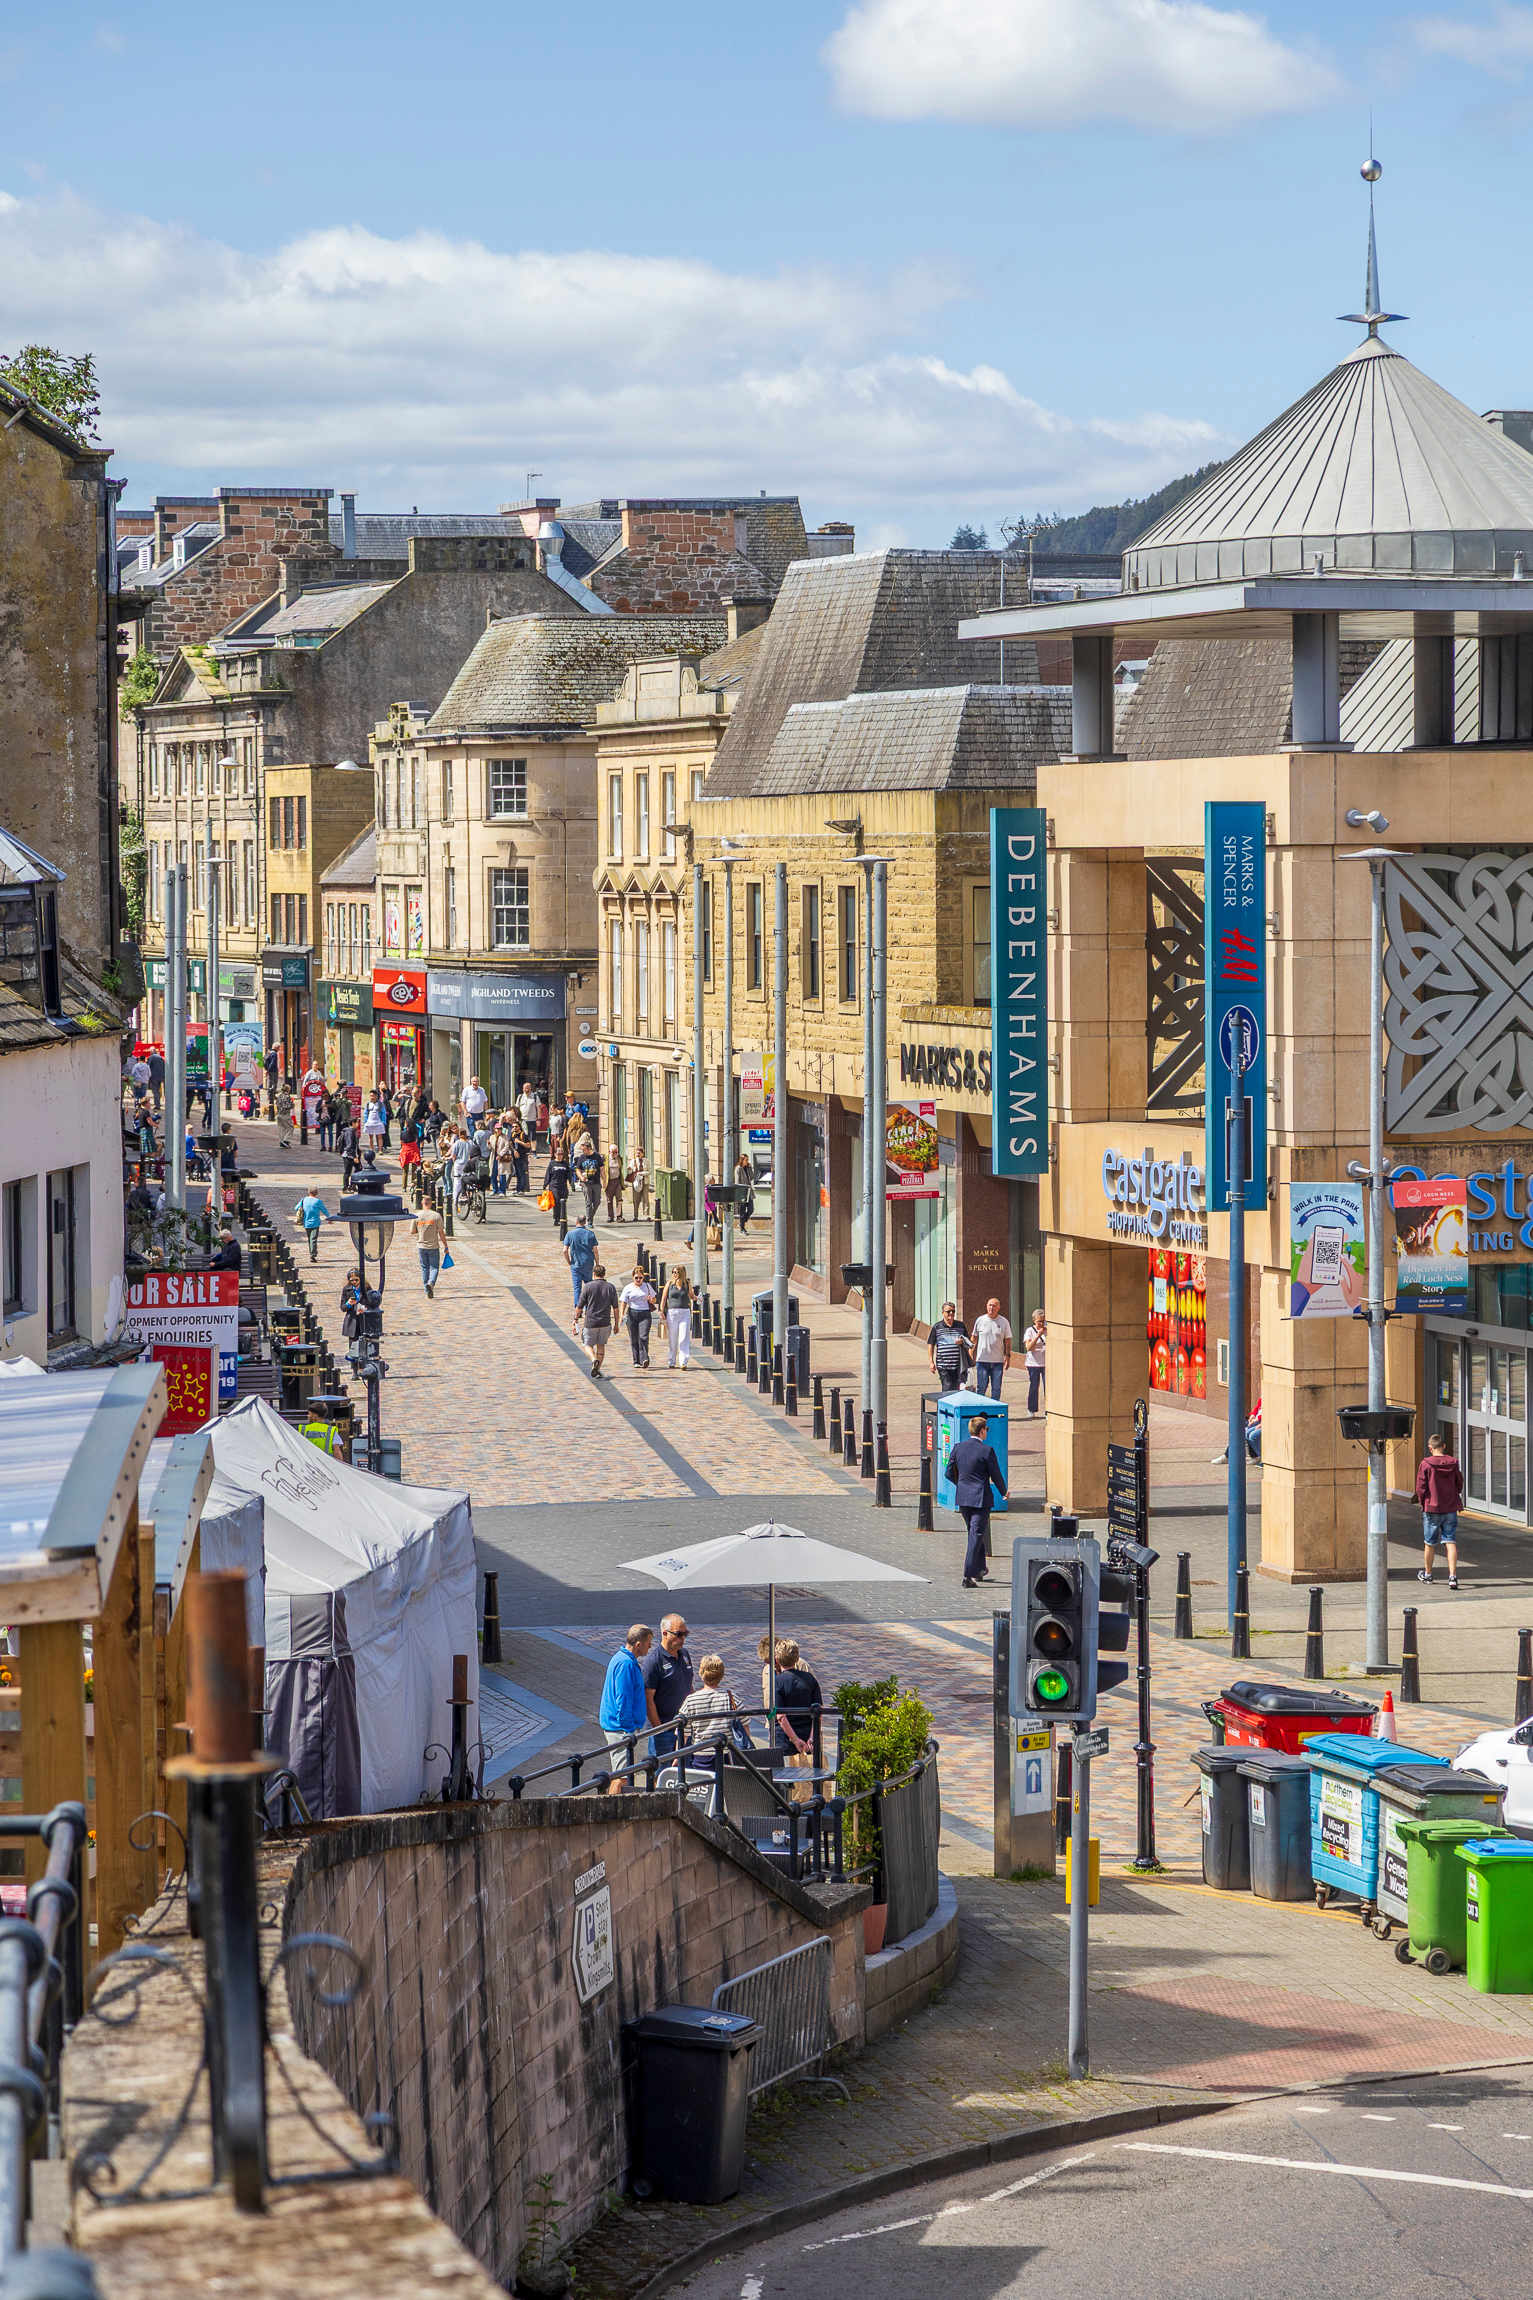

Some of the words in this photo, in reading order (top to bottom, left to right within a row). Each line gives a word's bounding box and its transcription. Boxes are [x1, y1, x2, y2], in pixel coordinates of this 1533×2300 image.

[1223, 835, 1237, 907] SPENCER
[1240, 835, 1254, 891] MARKS
[1241, 896, 1254, 907] &
[1220, 927, 1259, 983] H&M
[511, 988, 555, 998] TWEEDS
[1007, 834, 1038, 1157] DEBENHAMS
[900, 1042, 963, 1089] MARKS
[963, 1049, 978, 1092] &
[1101, 1148, 1201, 1238] eastgate
[1293, 1198, 1313, 1214] WALK
[1313, 1194, 1322, 1203] IN
[1324, 1194, 1339, 1203] THE
[1340, 1198, 1360, 1213] PARK
[1106, 1211, 1150, 1235] SHOPPING
[1169, 1220, 1203, 1243] CENTRE
[973, 1249, 1000, 1257] MARKS
[166, 1275, 220, 1306] SALE
[1422, 1285, 1445, 1295] Story
[170, 1314, 235, 1326] OPPORTUNITY
[1325, 1781, 1353, 1800] northern
[1327, 1817, 1345, 1835] Mixed
[1322, 1827, 1350, 1851] Recycling
